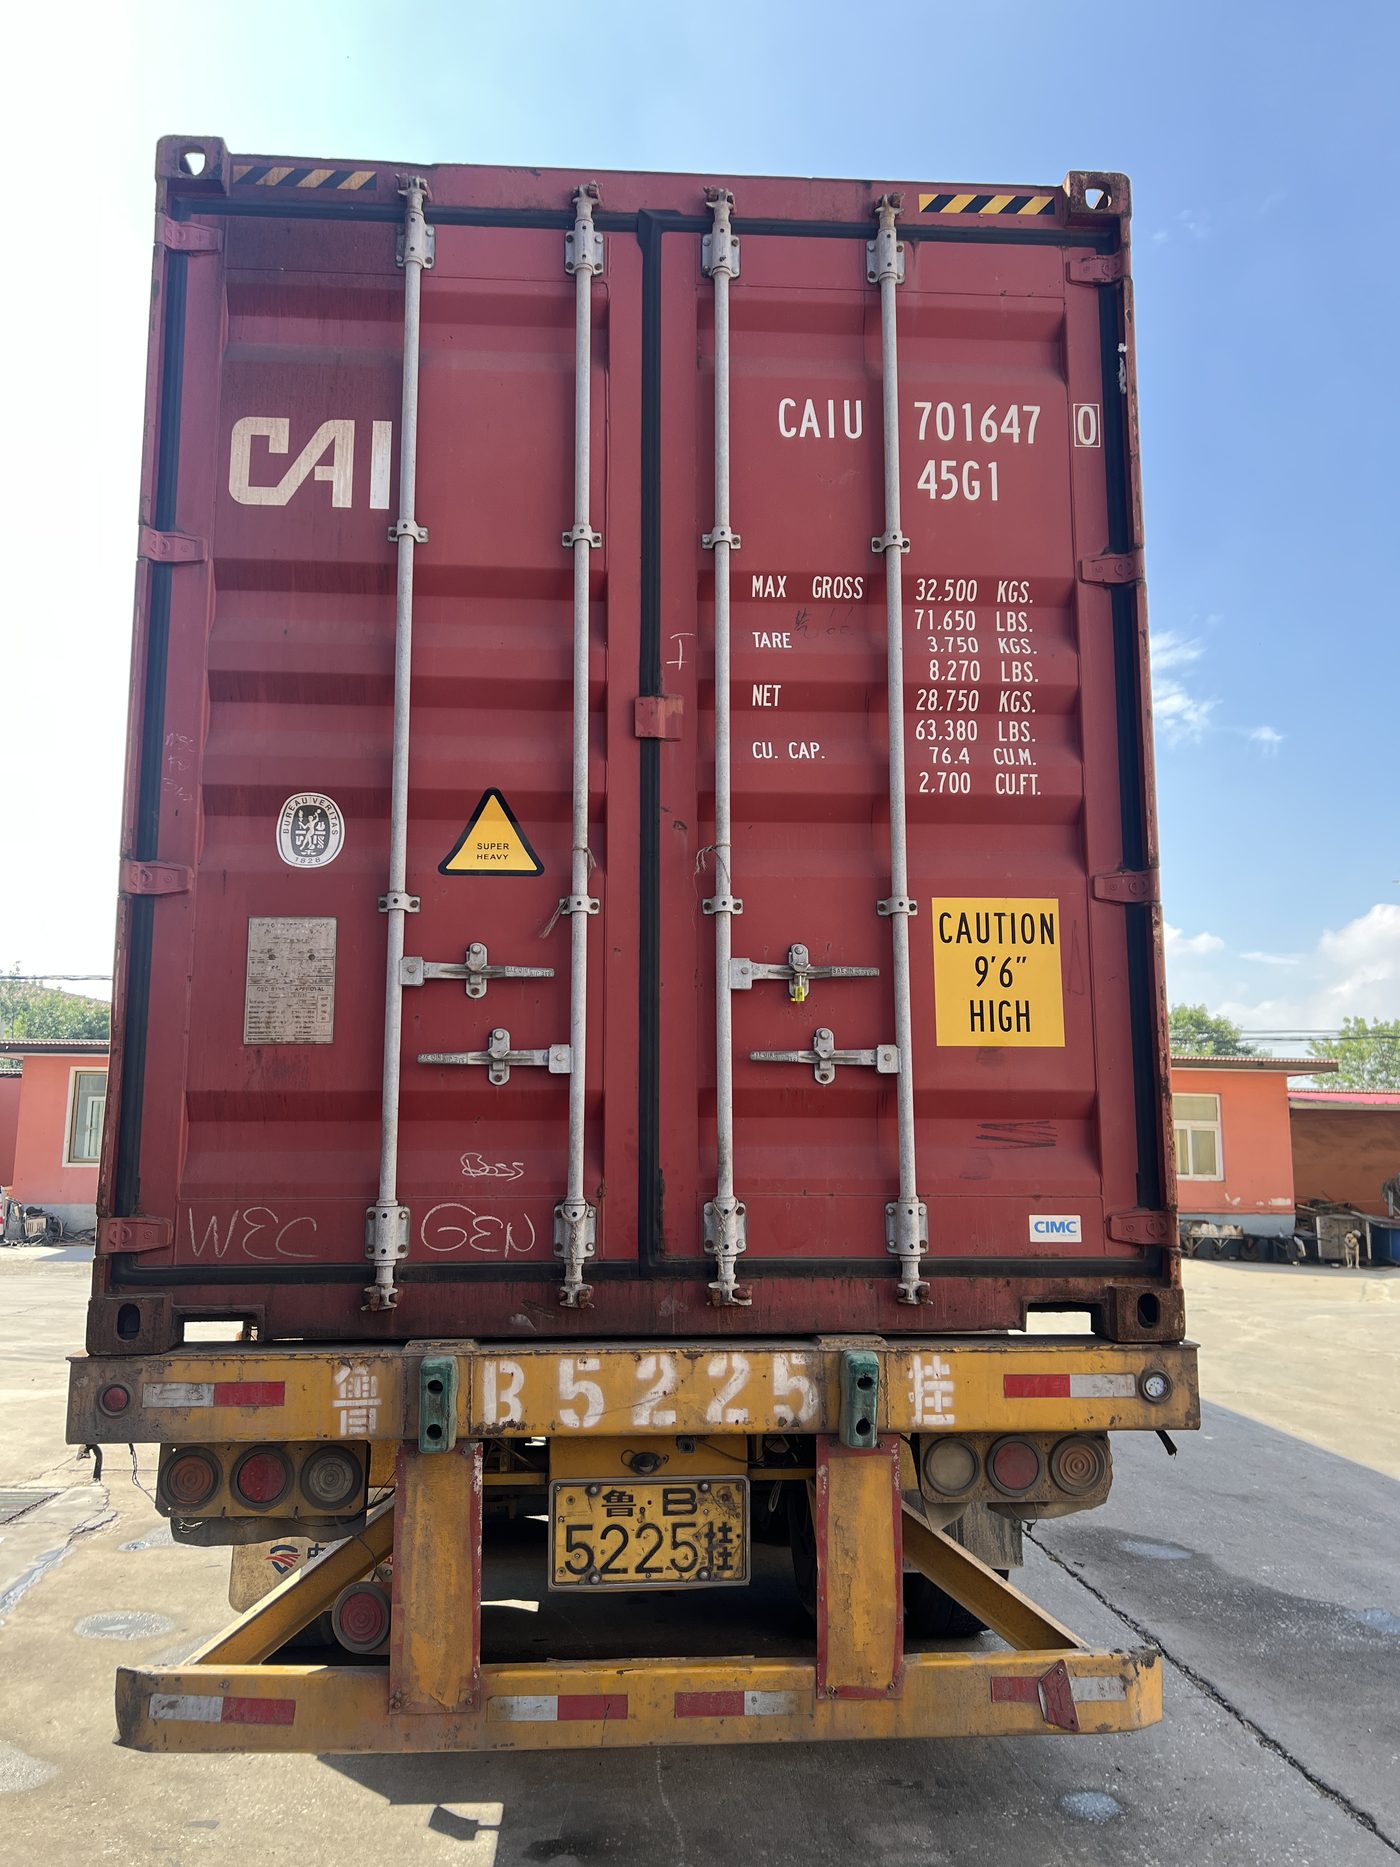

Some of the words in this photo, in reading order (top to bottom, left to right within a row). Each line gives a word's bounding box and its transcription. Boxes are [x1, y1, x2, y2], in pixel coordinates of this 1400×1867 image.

[778, 398, 863, 439] CAIU
[914, 402, 1041, 444] 701647
[1077, 405, 1097, 446] 0
[228, 416, 393, 510] CAI
[917, 460, 998, 501] 45G1
[752, 576, 787, 598] MAX
[812, 576, 864, 599] GROSS
[915, 579, 978, 602] 32,500
[996, 581, 1034, 604] KGS.
[914, 609, 976, 631] 71,650
[996, 611, 1033, 633] LBS.
[752, 632, 792, 648] TARE
[928, 637, 979, 653] 3,750
[998, 638, 1038, 655] KGS.
[929, 660, 981, 682] 8,270
[1001, 661, 1039, 682] LBS.
[752, 685, 782, 706] NET
[916, 689, 979, 712] 28,750
[999, 691, 1036, 713] KGS.
[916, 720, 978, 741] 63,380
[998, 721, 1036, 742] LBS.
[752, 742, 779, 759] CU.
[788, 742, 825, 759] CAP.
[928, 747, 970, 765] 76.4
[919, 772, 971, 794] 2,700
[282, 797, 308, 834] BUREAU
[312, 797, 339, 836] VERITAS
[476, 842, 510, 850] SUPER
[295, 856, 321, 864] 1828
[938, 912, 1055, 945] CAUTION
[969, 999, 1031, 1033] HIGH
[1033, 1220, 1078, 1234] CIMC
[564, 1521, 734, 1576] 5225挂
